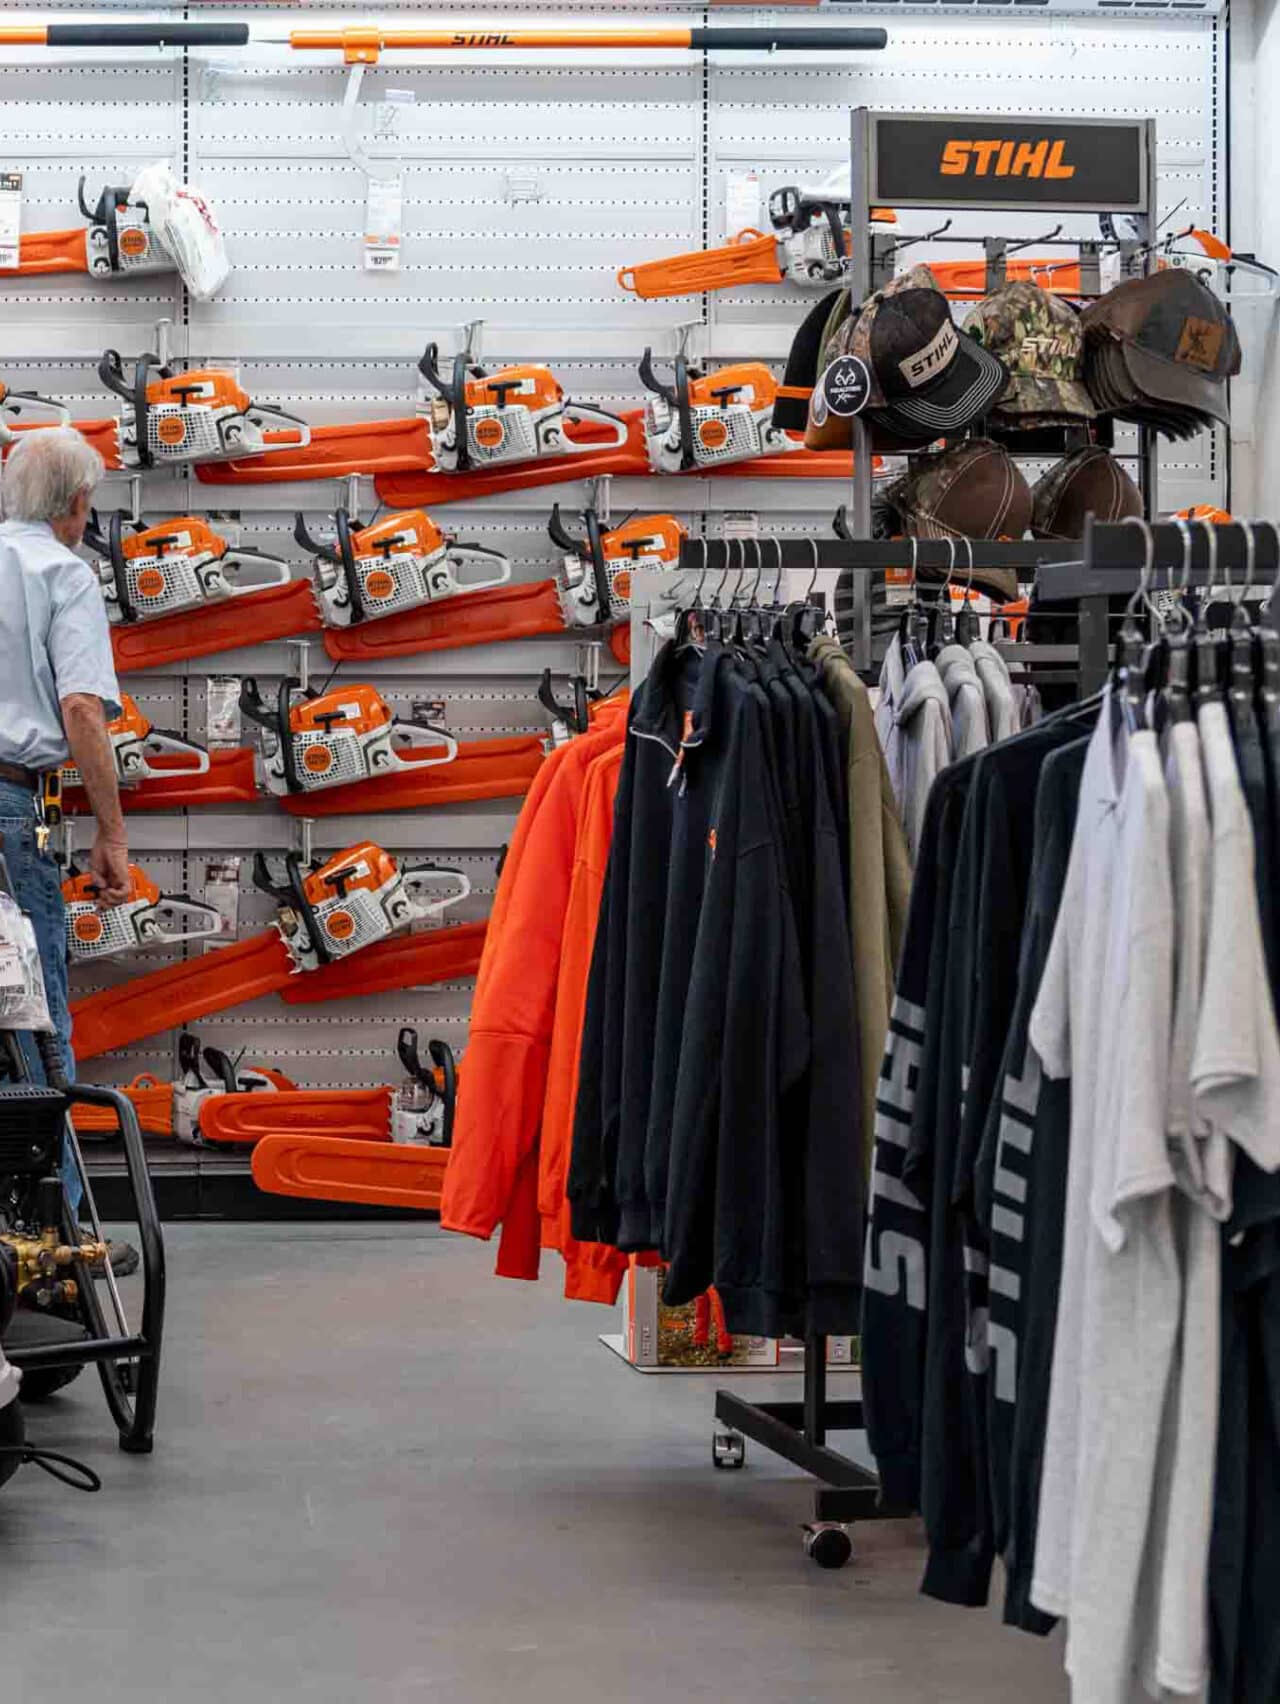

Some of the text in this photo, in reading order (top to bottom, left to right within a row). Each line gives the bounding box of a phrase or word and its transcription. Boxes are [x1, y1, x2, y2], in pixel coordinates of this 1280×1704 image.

[940, 139, 1076, 179] STIHL
[911, 332, 954, 377] STIHL
[1021, 337, 1079, 357] STIHL
